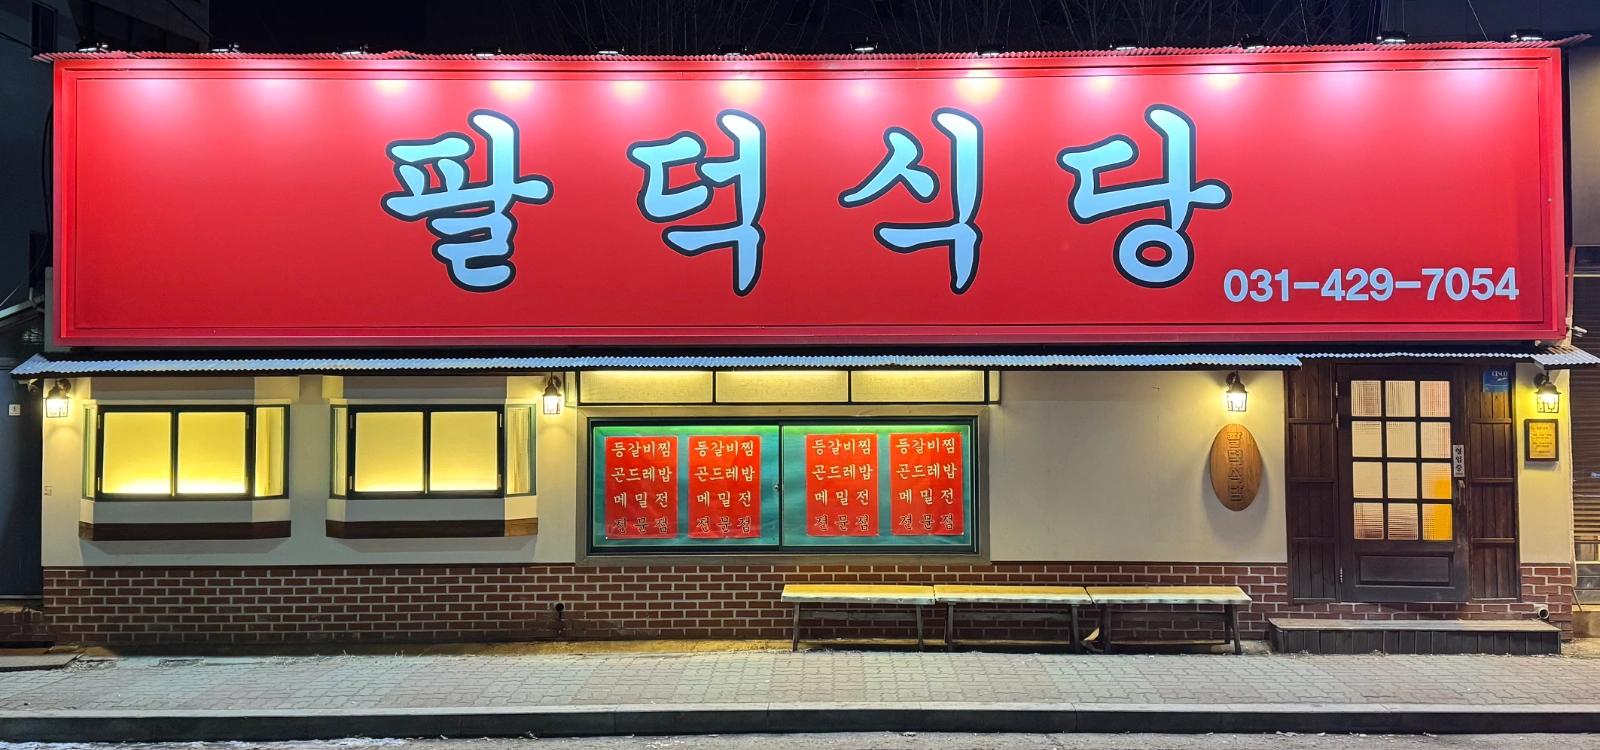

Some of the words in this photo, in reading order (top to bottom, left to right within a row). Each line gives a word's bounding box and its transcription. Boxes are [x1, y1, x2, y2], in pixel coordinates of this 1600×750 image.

[380, 105, 1231, 297] 팔덕식당
[1223, 267, 1520, 303] 031-429-7054
[611, 440, 671, 458] 등갈비찜
[694, 440, 754, 457] 등갈비찜
[812, 438, 871, 455] 등갈비찜
[895, 437, 955, 455] 등갈비찜
[1455, 445, 1463, 472] 영업중
[611, 466, 673, 483] 곤드레밥
[694, 465, 756, 483] 곤드레밥
[812, 464, 873, 481] 곤드레밥
[896, 462, 957, 480] 곤드레밥
